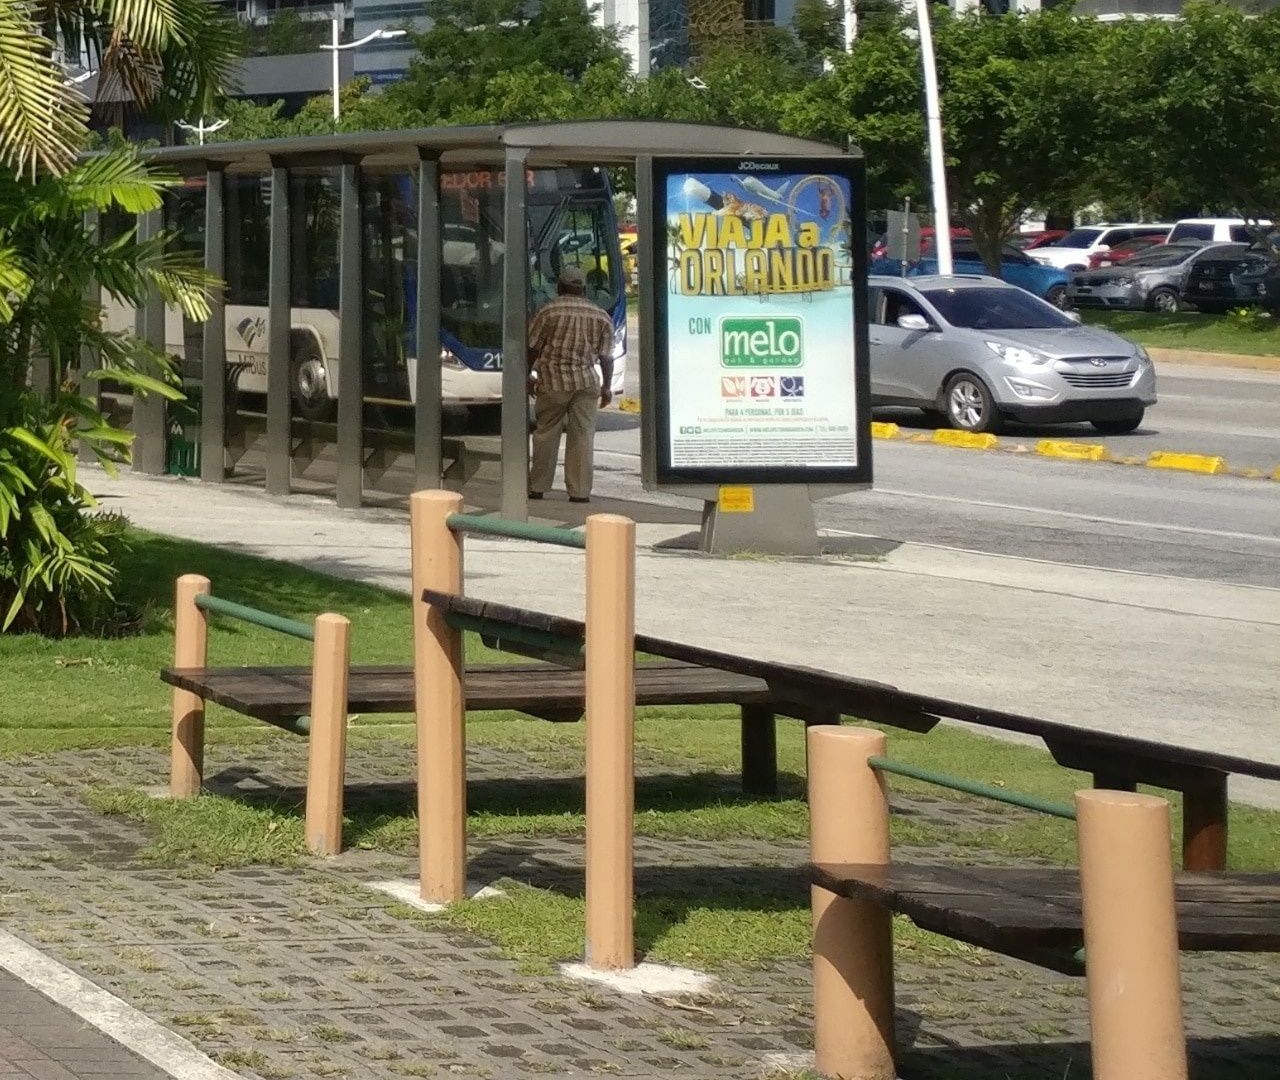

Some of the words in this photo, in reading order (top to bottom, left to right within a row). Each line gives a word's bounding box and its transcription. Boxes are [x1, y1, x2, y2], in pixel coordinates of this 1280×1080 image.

[679, 212, 792, 249] VIAJA
[796, 221, 821, 248] a
[680, 248, 835, 296] ORLANDO
[688, 317, 711, 335] CON
[724, 322, 800, 356] melo
[483, 352, 503, 369] 21
